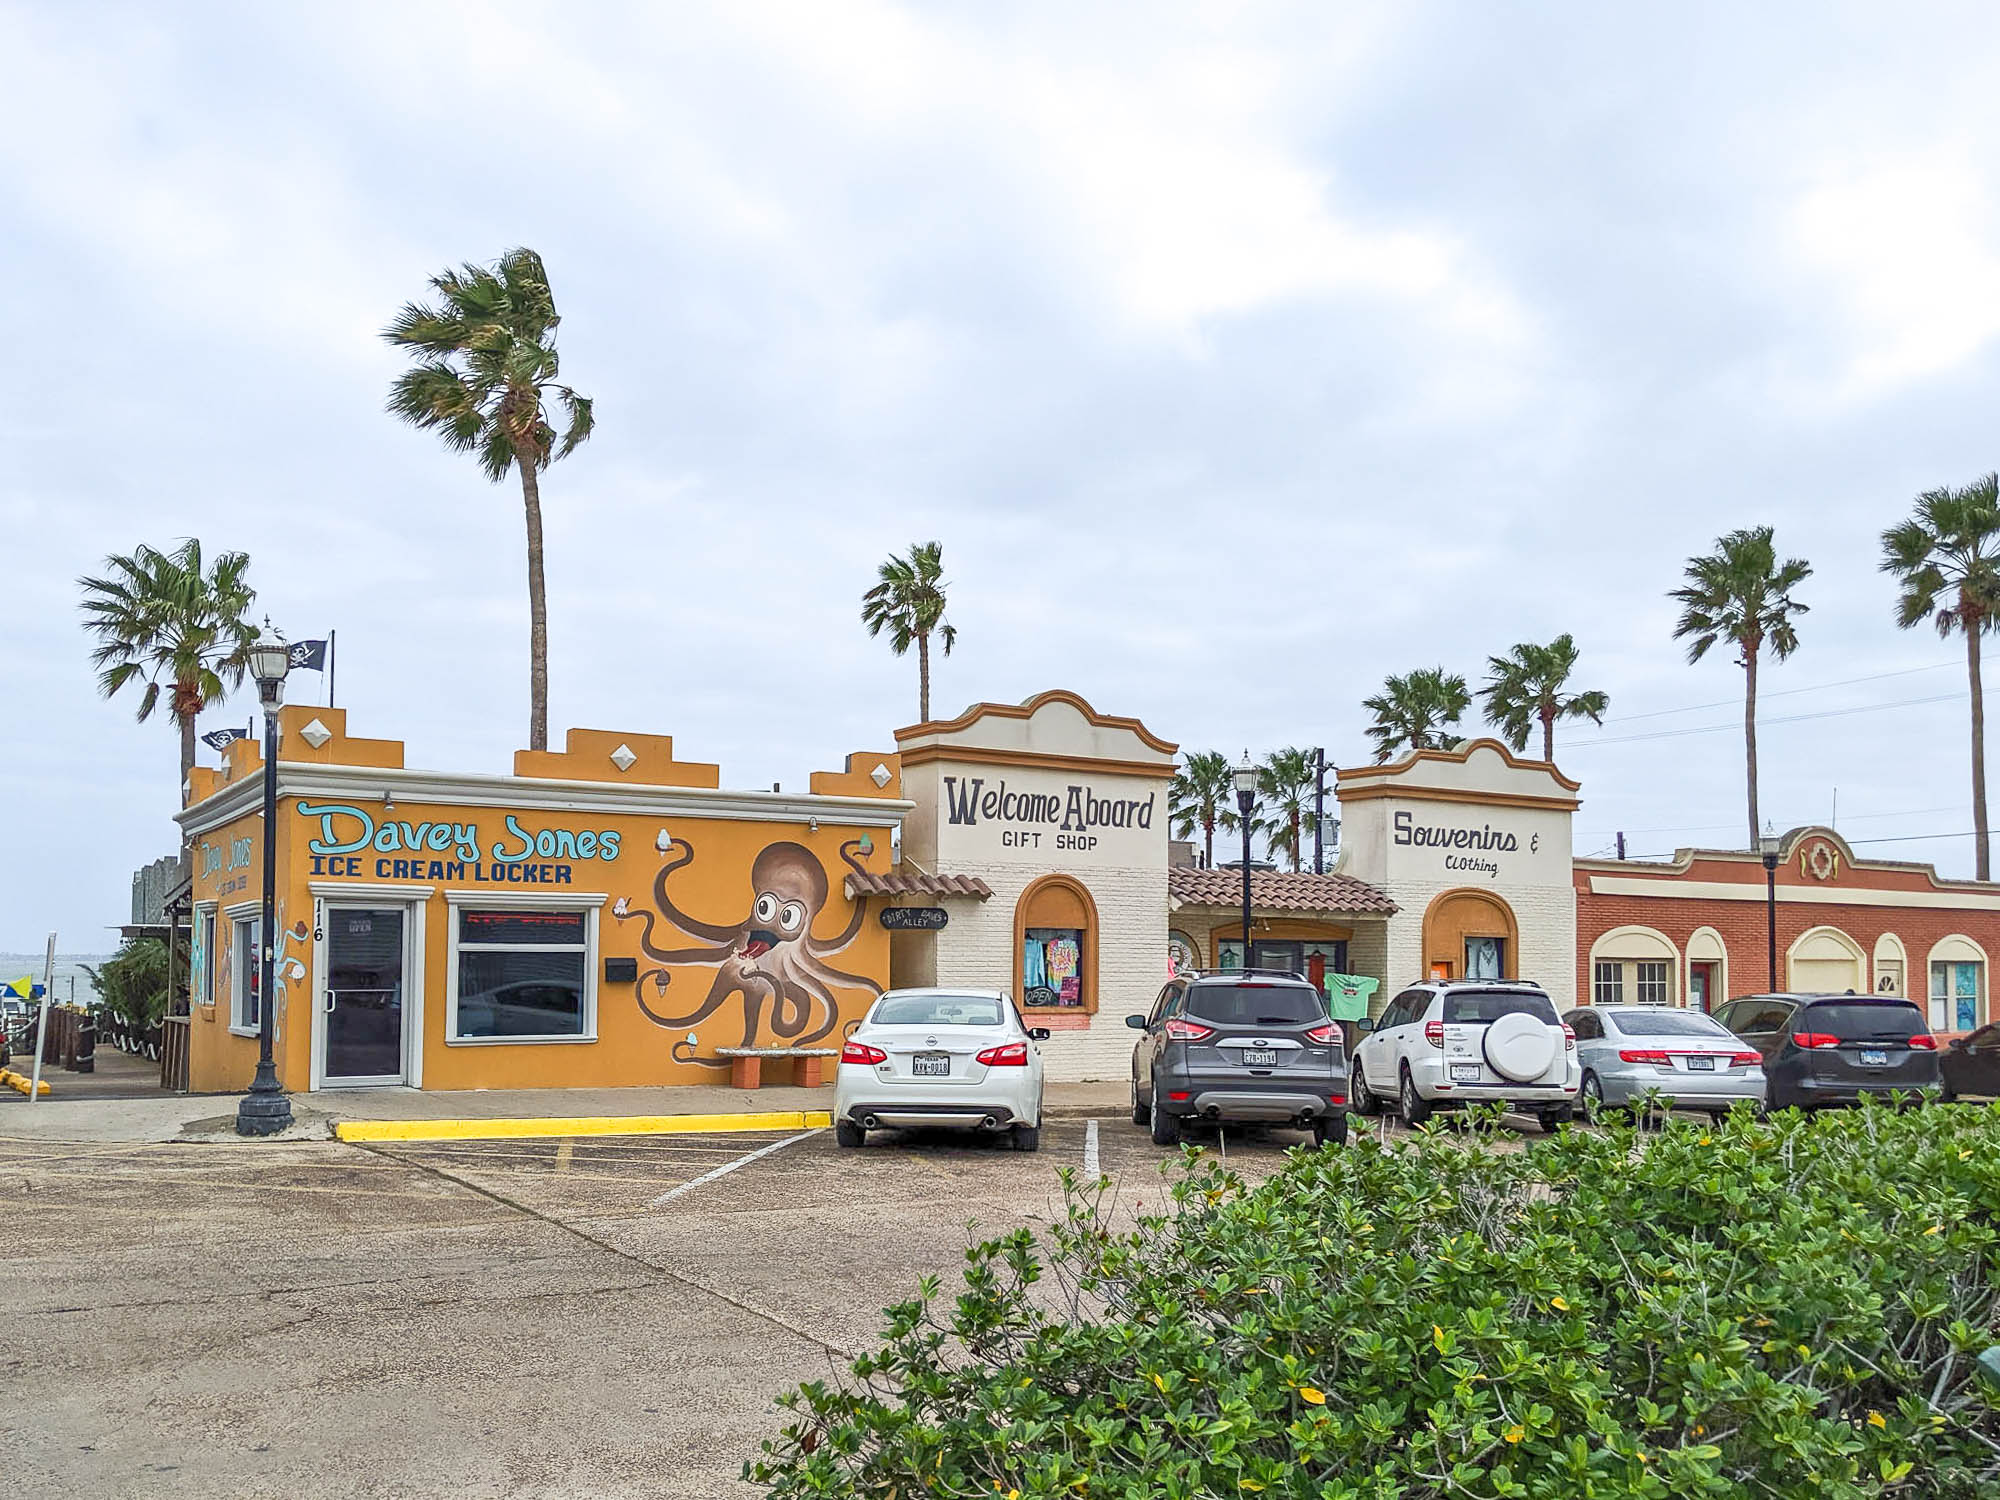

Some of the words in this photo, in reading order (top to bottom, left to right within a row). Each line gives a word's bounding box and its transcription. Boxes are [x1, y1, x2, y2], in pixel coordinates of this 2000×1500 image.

[944, 776, 1060, 825] Welcome
[1060, 785, 1155, 832] Aboard
[297, 801, 480, 863] Davey
[493, 815, 621, 863] Jones
[1002, 831, 1042, 848] GIFT
[1056, 834, 1097, 851] SHOP
[1394, 811, 1519, 852] Souvenirs
[309, 855, 362, 877] ICE
[376, 859, 464, 880] CREAM
[474, 861, 572, 884] LOCKER
[314, 898, 323, 941] 116
[886, 908, 911, 924] DIRTY
[902, 918, 928, 927] ALLEY
[1025, 990, 1053, 1001] OPEN
